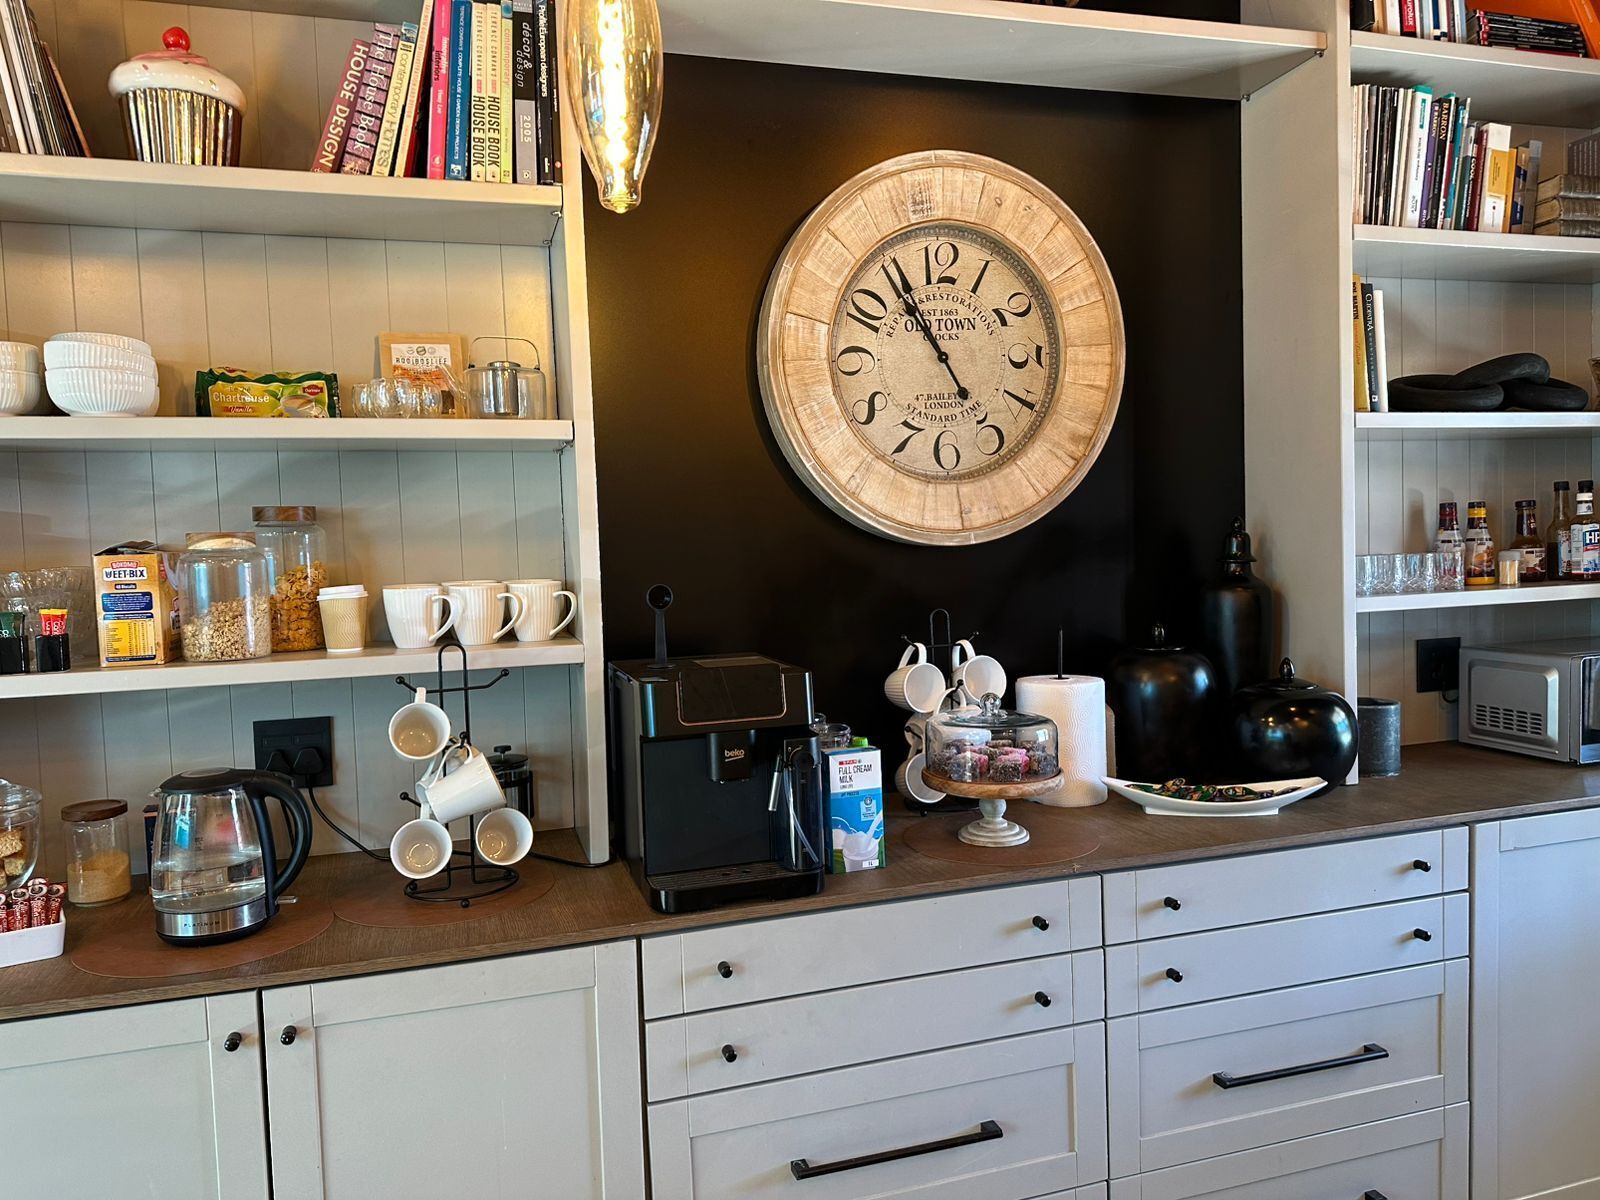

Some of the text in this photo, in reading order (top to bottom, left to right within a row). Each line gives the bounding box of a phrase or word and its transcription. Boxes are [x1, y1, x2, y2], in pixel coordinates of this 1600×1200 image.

[503, 28, 511, 85] contemporary
[522, 22, 532, 58] décor
[538, 27, 547, 62] European
[514, 50, 525, 87] design
[523, 60, 533, 69] &
[539, 63, 548, 97] designers
[353, 32, 393, 152] The House Book
[390, 53, 409, 118] contemporary
[318, 44, 369, 168] HOUSE DESIGN
[473, 95, 485, 133] HOUSE
[488, 95, 500, 133] HOUSE
[1439, 102, 1450, 141] BARRON
[523, 115, 532, 143] 2005
[453, 135, 461, 159] PROJECTS
[473, 136, 485, 167] BOOK
[488, 136, 500, 168] BOOK
[915, 241, 960, 286] 12
[967, 258, 995, 296] 1
[845, 288, 887, 337] 10
[922, 308, 959, 317] EST 1863
[936, 317, 977, 332] TOWN
[992, 291, 1032, 327] 2
[922, 332, 960, 341] COCKS
[1007, 336, 1044, 370] 3
[836, 345, 876, 376] 9
[852, 391, 888, 425] 8
[905, 399, 982, 423] STANDARD TIME
[924, 401, 964, 410] LONDON
[1002, 385, 1037, 423] 4
[892, 419, 925, 456] 7
[933, 429, 961, 471] 6
[976, 411, 1005, 456] 5
[104, 569, 146, 579] WEET-BIX
[724, 748, 745, 758] beko
[838, 764, 873, 775] FULL CREAM
[839, 775, 853, 784] MILK
